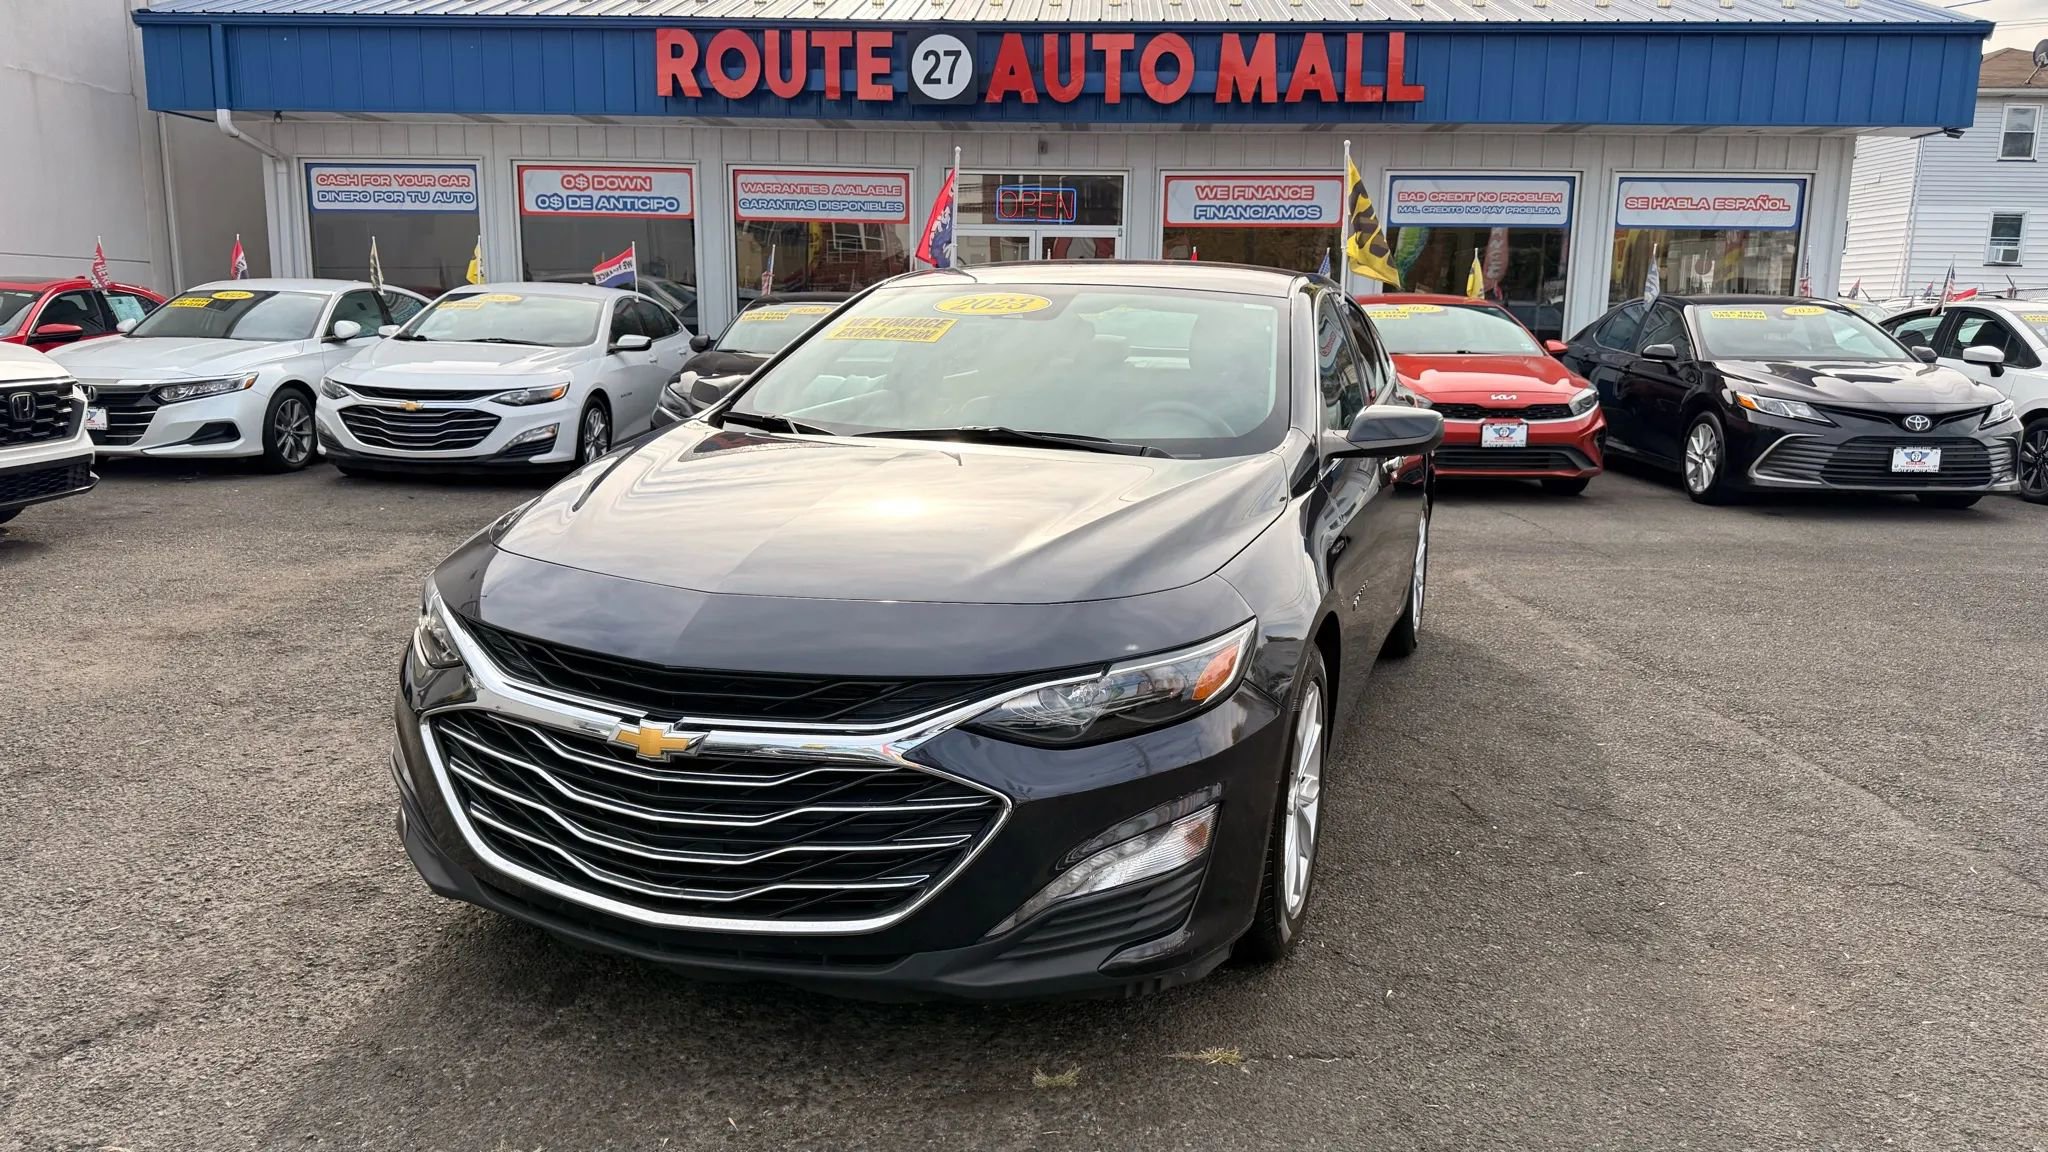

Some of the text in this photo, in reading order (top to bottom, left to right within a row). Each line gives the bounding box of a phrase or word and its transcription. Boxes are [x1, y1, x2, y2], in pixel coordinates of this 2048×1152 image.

[656, 28, 1425, 104] ROUTE 27 AUTO MALL
[316, 174, 470, 187] CASH FOR YOUR CAR
[592, 175, 653, 191] DOWN
[741, 182, 902, 196] WARRANTIES AVAILABLE
[1195, 185, 1315, 200] WE FINANCE
[317, 191, 474, 204] DINERO POR TU AUTO
[566, 194, 593, 211] DE
[595, 196, 680, 212] ANTICIPO
[1397, 191, 1563, 203] BAD CREDIT NO PROBLEM
[1625, 194, 1791, 212] SE HABLA ESPAÑOL
[739, 198, 904, 213] GARANTIAS DISPONIBLES
[1000, 190, 1074, 219] OPEN
[1397, 205, 1561, 215] MAL CREDITO NO HAY PROBLEMA
[1194, 204, 1322, 220] FINANCIAMOS
[949, 297, 1036, 311] 2023
[845, 318, 952, 329] WE FINANCE
[834, 327, 938, 339] EXTRA CLEAN
